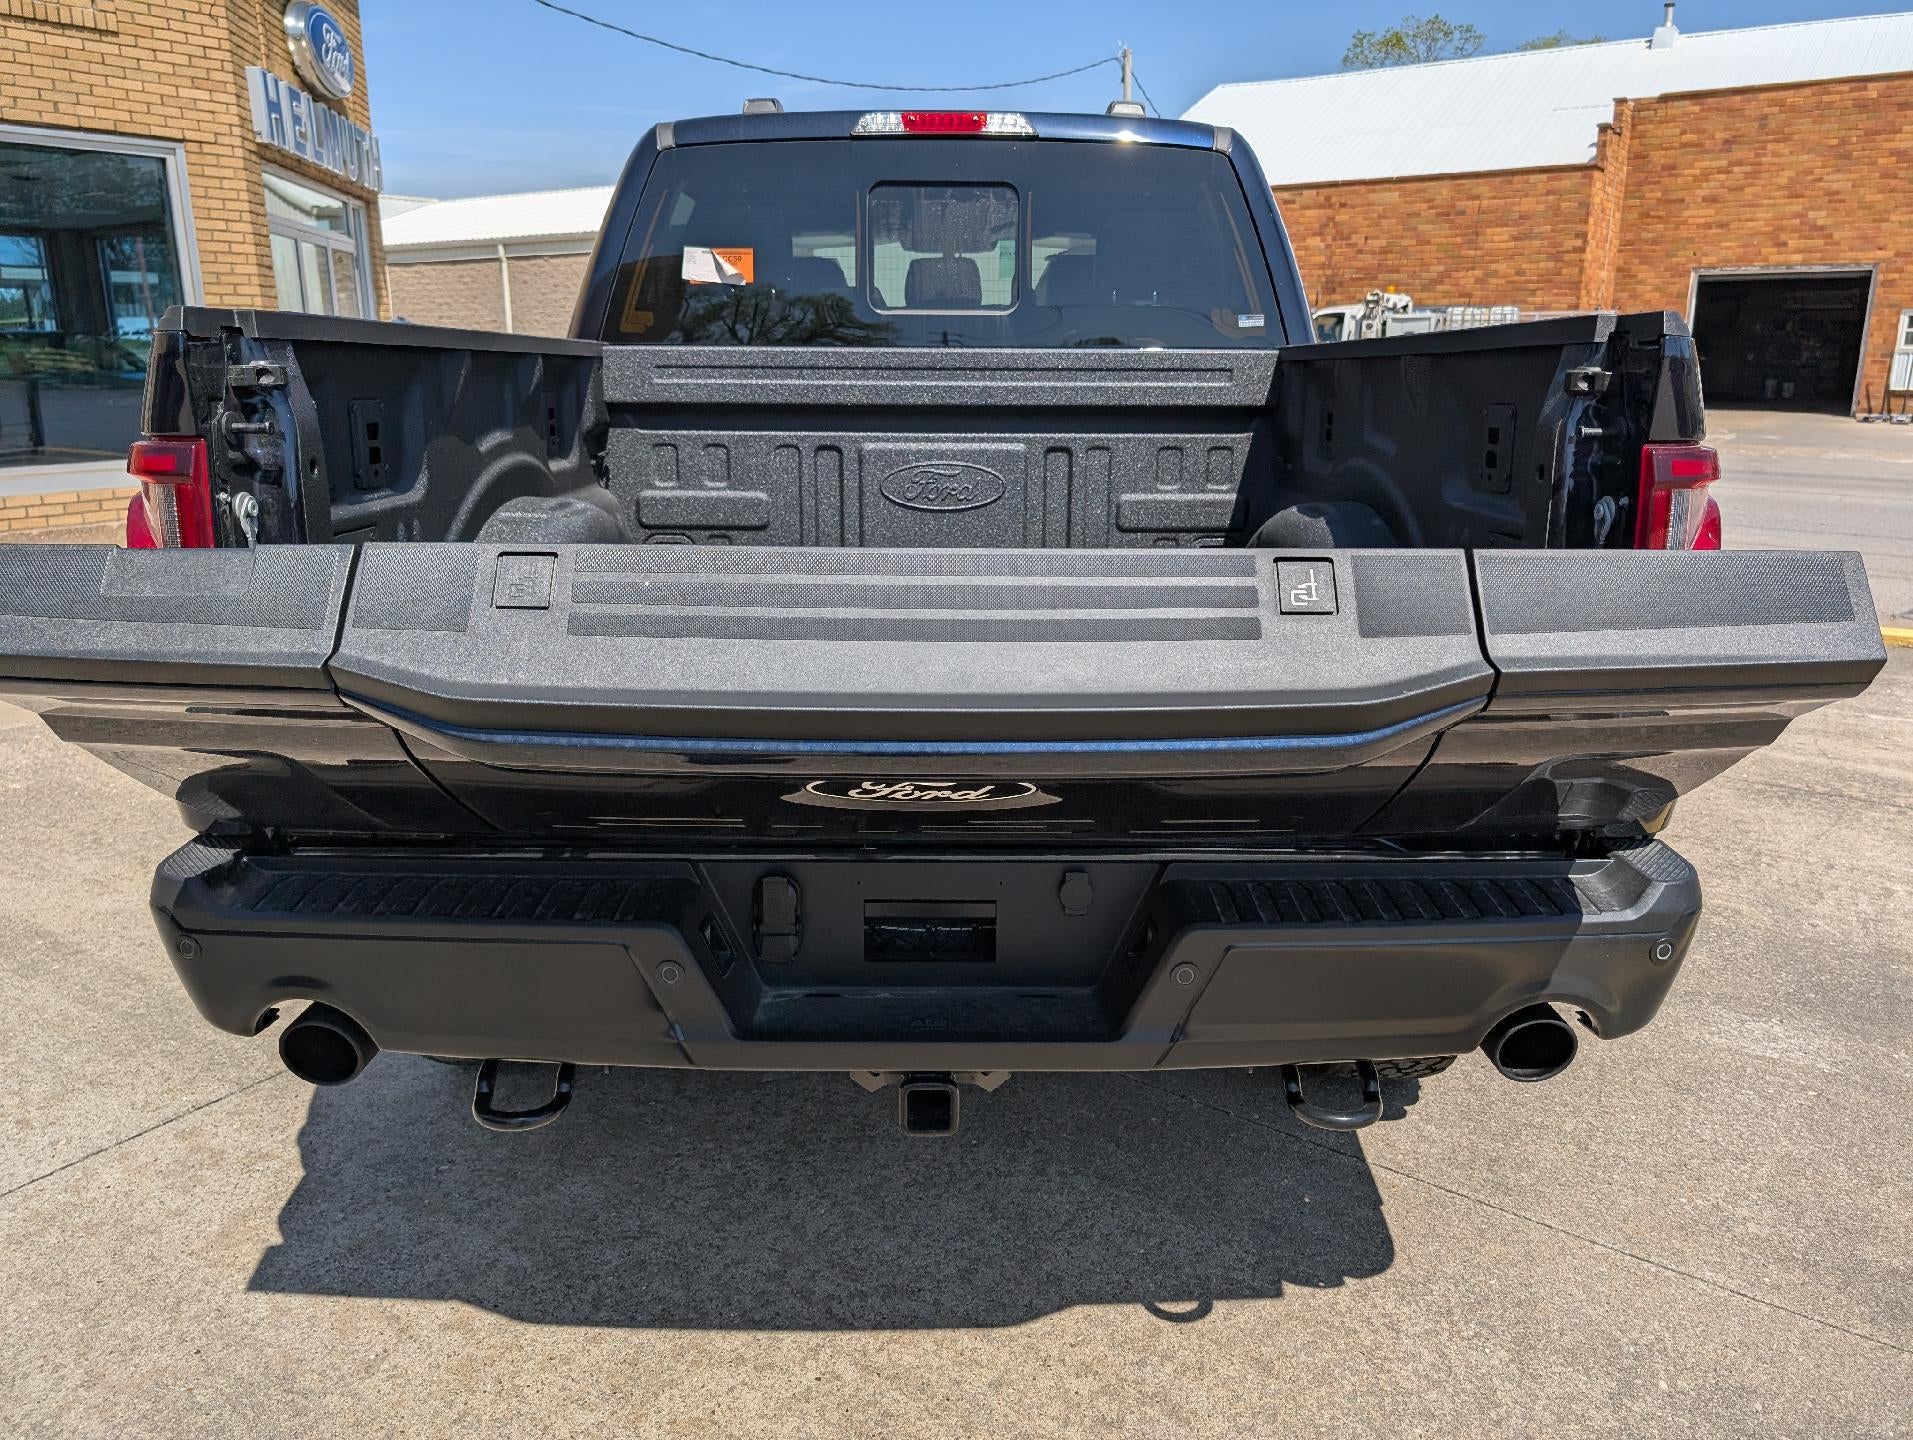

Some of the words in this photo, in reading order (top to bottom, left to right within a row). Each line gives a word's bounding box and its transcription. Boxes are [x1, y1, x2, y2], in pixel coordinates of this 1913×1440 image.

[321, 23, 350, 76] Ford
[246, 66, 383, 193] HELMUTH
[903, 468, 981, 502] Ford
[848, 781, 995, 800] Ford
